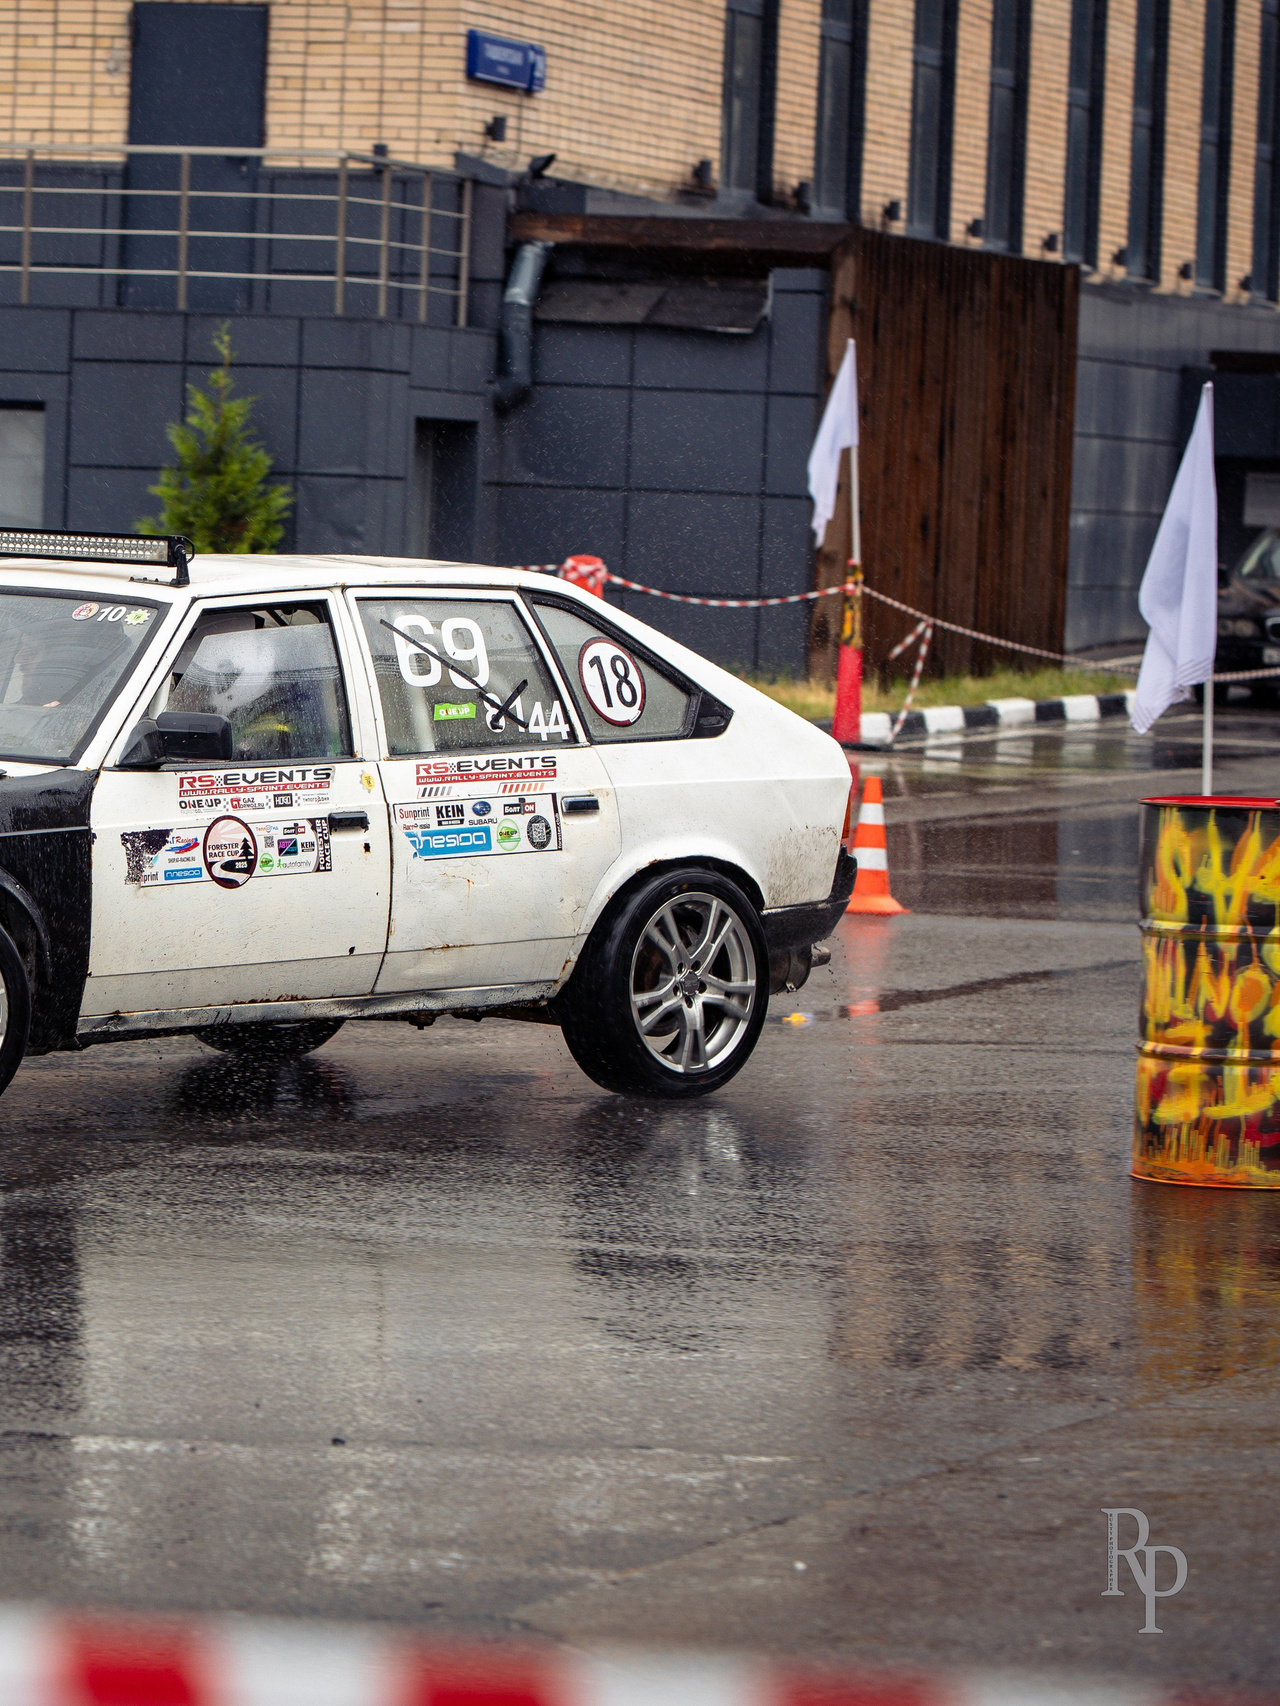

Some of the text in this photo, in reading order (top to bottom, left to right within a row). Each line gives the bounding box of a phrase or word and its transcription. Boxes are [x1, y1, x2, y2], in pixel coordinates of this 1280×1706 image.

[97, 606, 127, 622] 10
[393, 615, 491, 690] 69
[588, 655, 638, 709] 18
[456, 756, 557, 772] EVENTS
[223, 768, 332, 786] EVENTS
[436, 804, 465, 819] KEIN
[468, 817, 498, 826] SUBARU
[208, 843, 239, 851] FORESTER
[300, 841, 316, 849] KEIN
[316, 819, 325, 871] FORESTER
[322, 819, 332, 870] RACE CUP
[208, 850, 240, 859] RACE CUP
